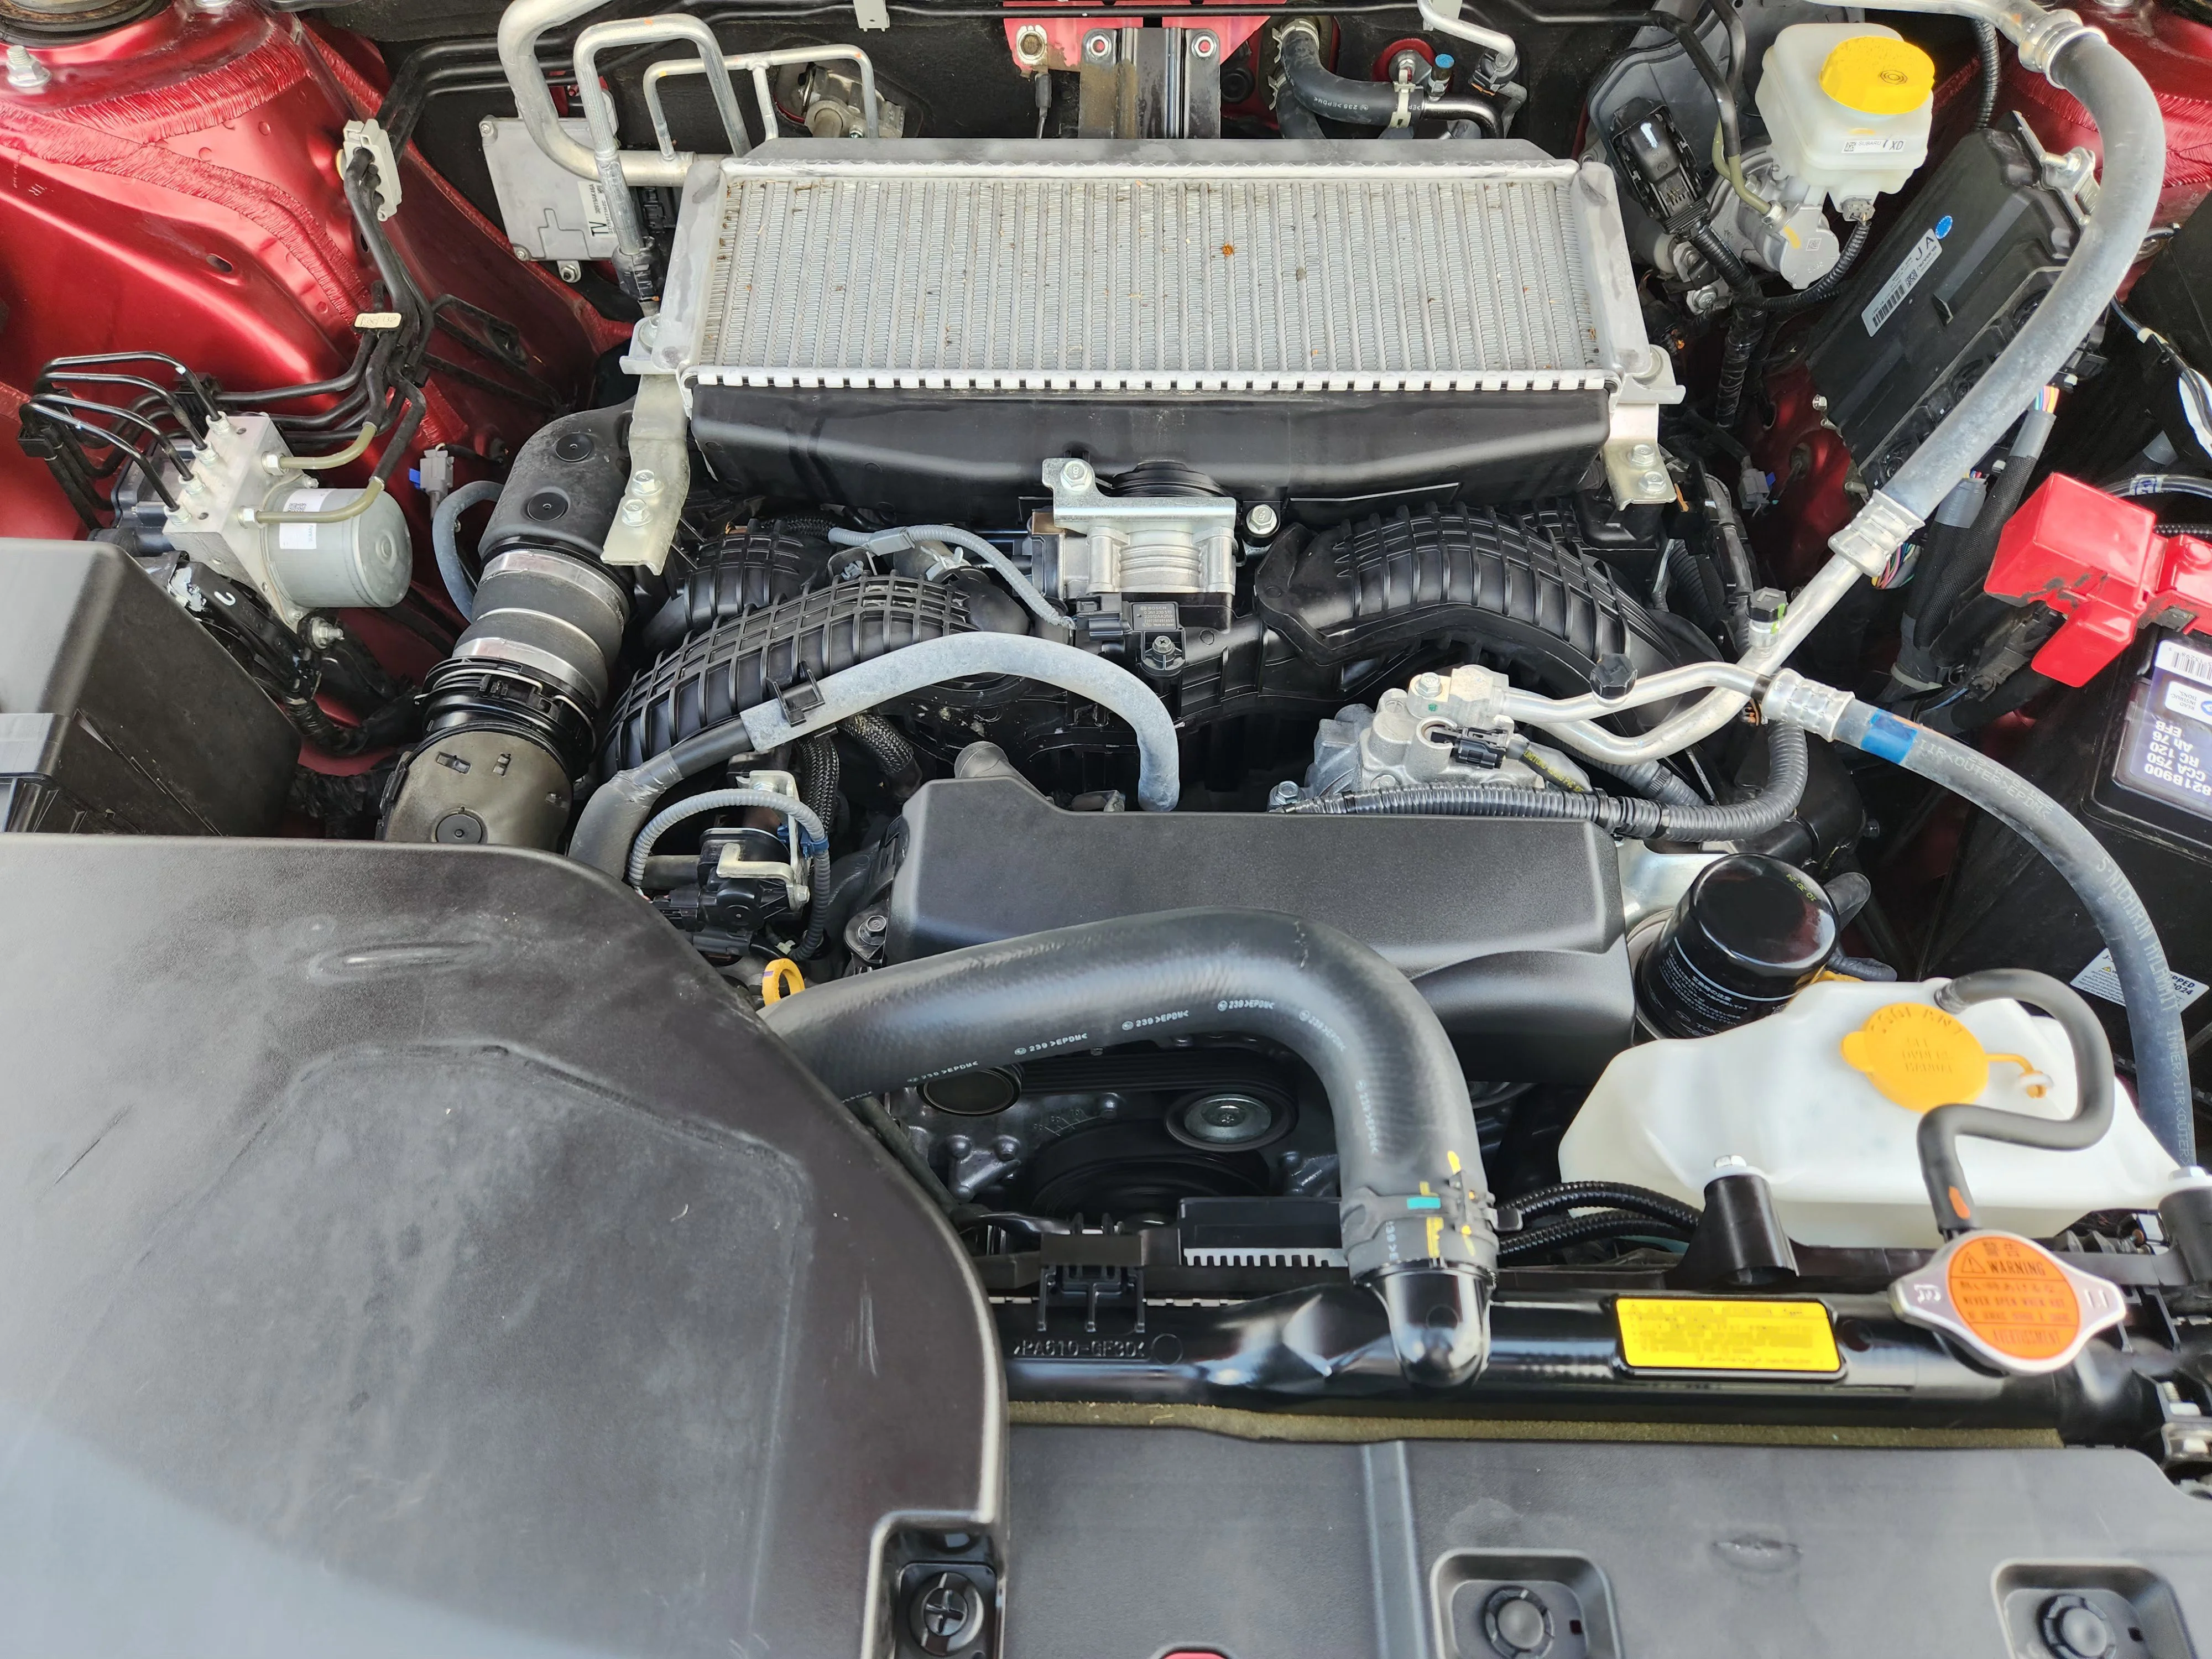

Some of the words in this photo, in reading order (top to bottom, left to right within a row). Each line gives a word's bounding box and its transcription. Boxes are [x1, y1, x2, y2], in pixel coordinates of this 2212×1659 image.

[1889, 140, 1904, 150] XD
[588, 221, 608, 237] TV
[2156, 721, 2182, 738] EFB
[2152, 731, 2170, 745] 76
[2174, 738, 2194, 753] Ah
[2150, 742, 2176, 759] 120
[2147, 753, 2173, 771] 750
[2179, 753, 2200, 768] RC
[2177, 763, 2206, 782] CCA
[1155, 1010, 1189, 1024] >EPDM<
[1050, 1032, 1088, 1046] >EPDM<
[1987, 1260, 2046, 1276] WARNING
